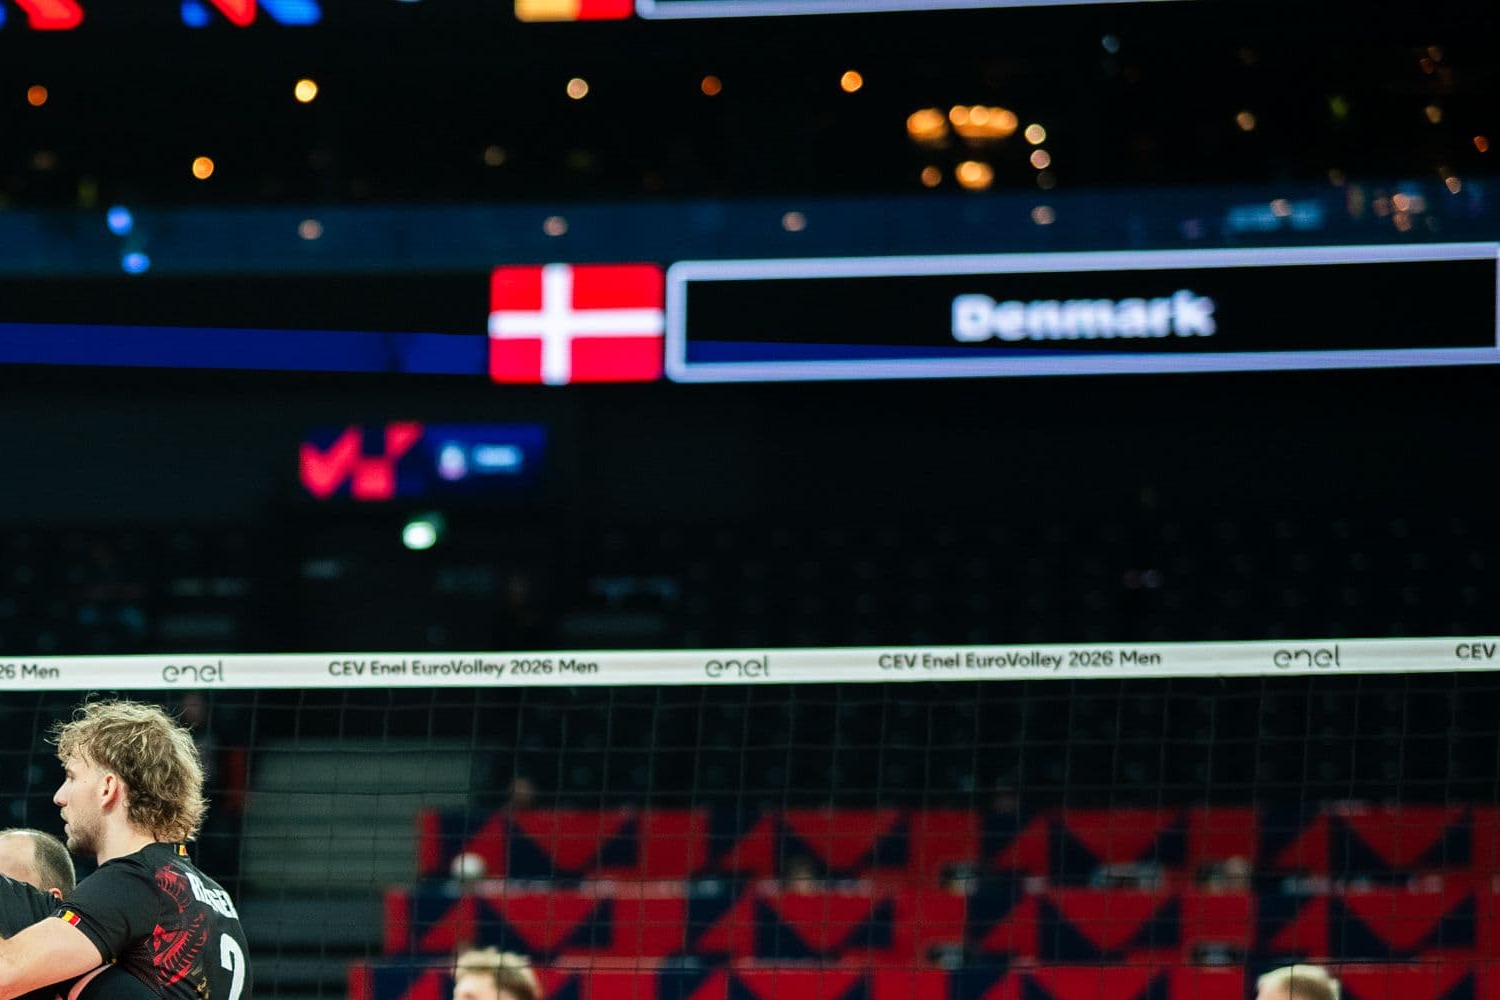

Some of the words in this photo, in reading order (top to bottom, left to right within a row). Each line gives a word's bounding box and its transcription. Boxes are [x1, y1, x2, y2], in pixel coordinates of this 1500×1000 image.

[951, 290, 1217, 343] Denmark
[877, 653, 918, 670] CEV
[921, 652, 961, 669] Enel
[965, 651, 1064, 671] EuroVolley
[1068, 650, 1114, 668] 2026
[1119, 649, 1162, 666] Men
[1272, 645, 1341, 668] enel
[1454, 643, 1497, 660] CEV
[20, 663, 60, 679] Men
[162, 660, 224, 683] enel
[327, 660, 366, 677] CEV
[369, 660, 408, 676] Enel
[411, 659, 506, 678] EuroVolley
[510, 659, 554, 675] 2026
[558, 658, 600, 674] Men
[704, 655, 769, 677] enel
